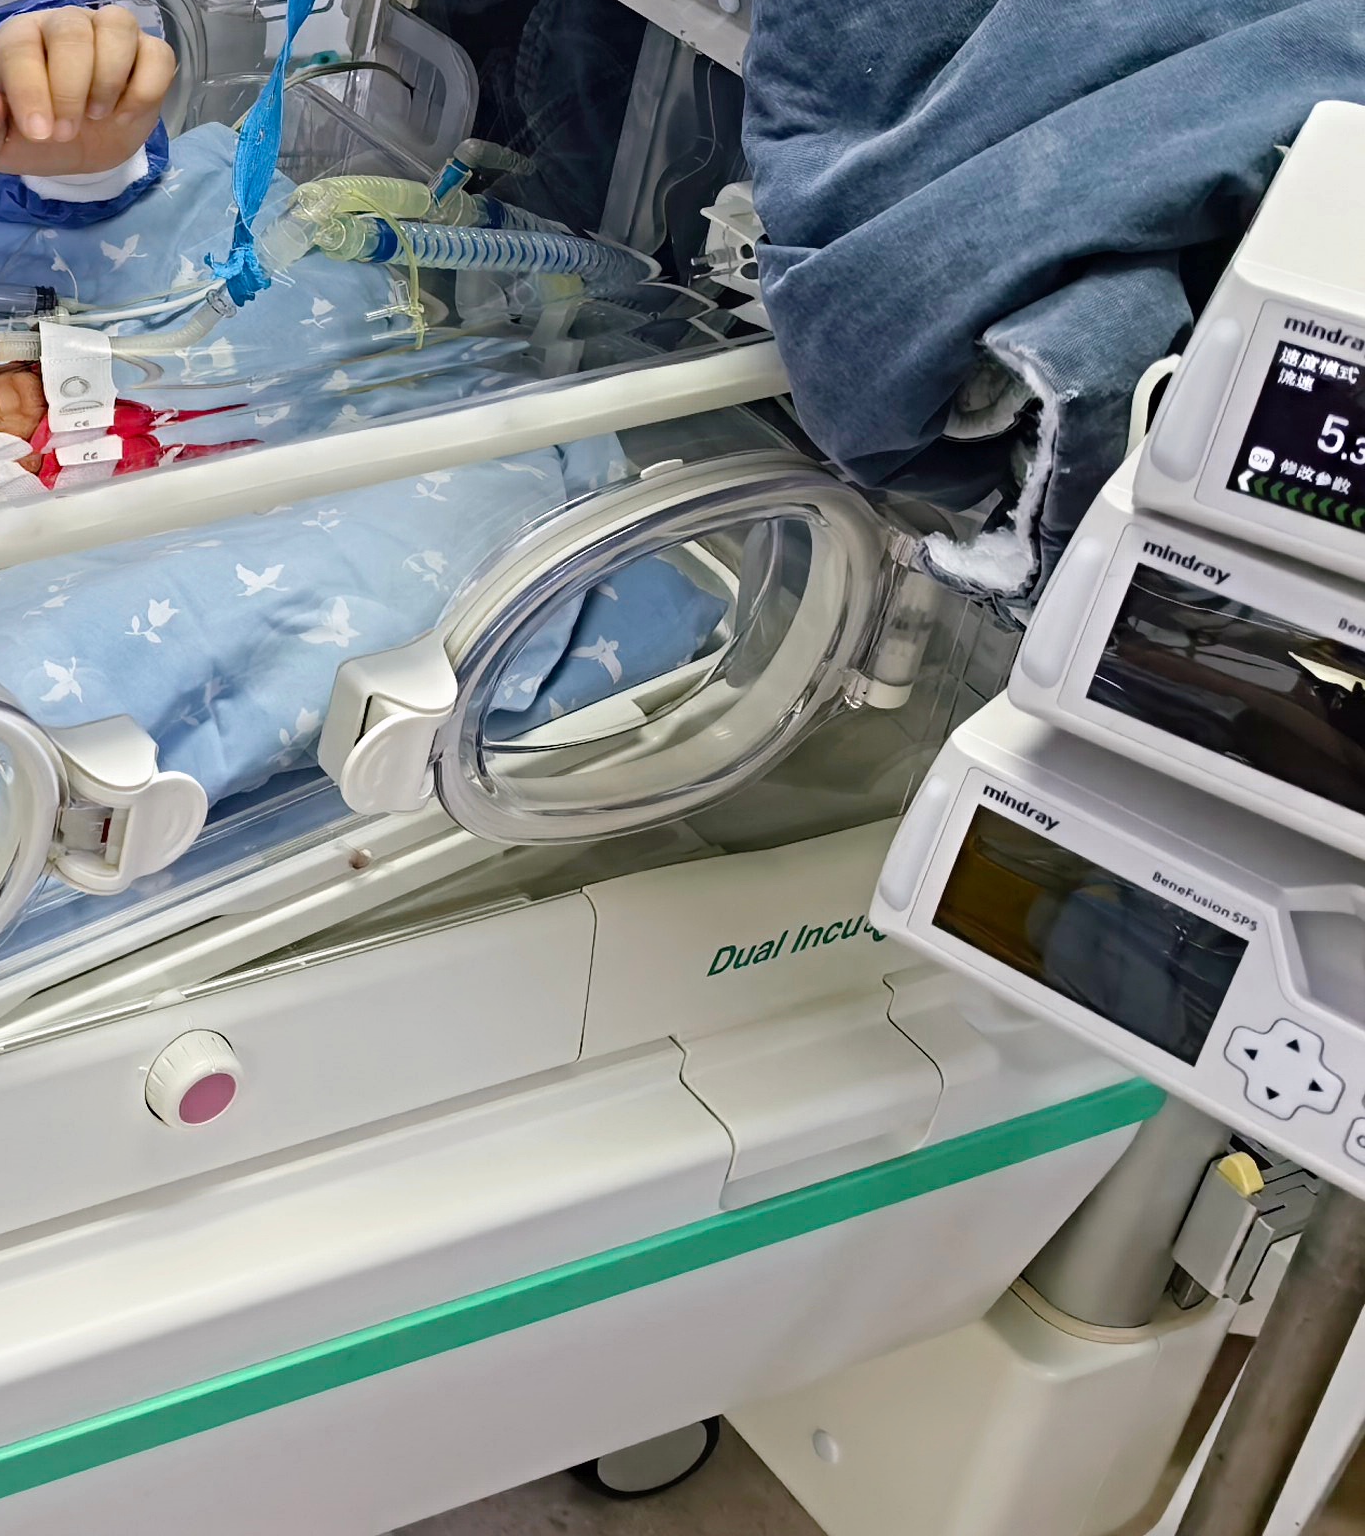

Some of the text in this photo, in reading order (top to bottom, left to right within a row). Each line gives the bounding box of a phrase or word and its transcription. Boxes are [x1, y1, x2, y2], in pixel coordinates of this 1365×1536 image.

[1284, 317, 1365, 354] mindra
[1277, 367, 1315, 392] 流速
[1279, 346, 1360, 385] 速度模式
[1252, 453, 1269, 464] OK
[1280, 459, 1352, 495] 修改参数
[1143, 541, 1231, 585] mindray
[982, 784, 1060, 831] mindray
[1152, 871, 1230, 918] BeneFusion
[707, 930, 789, 977] Dual
